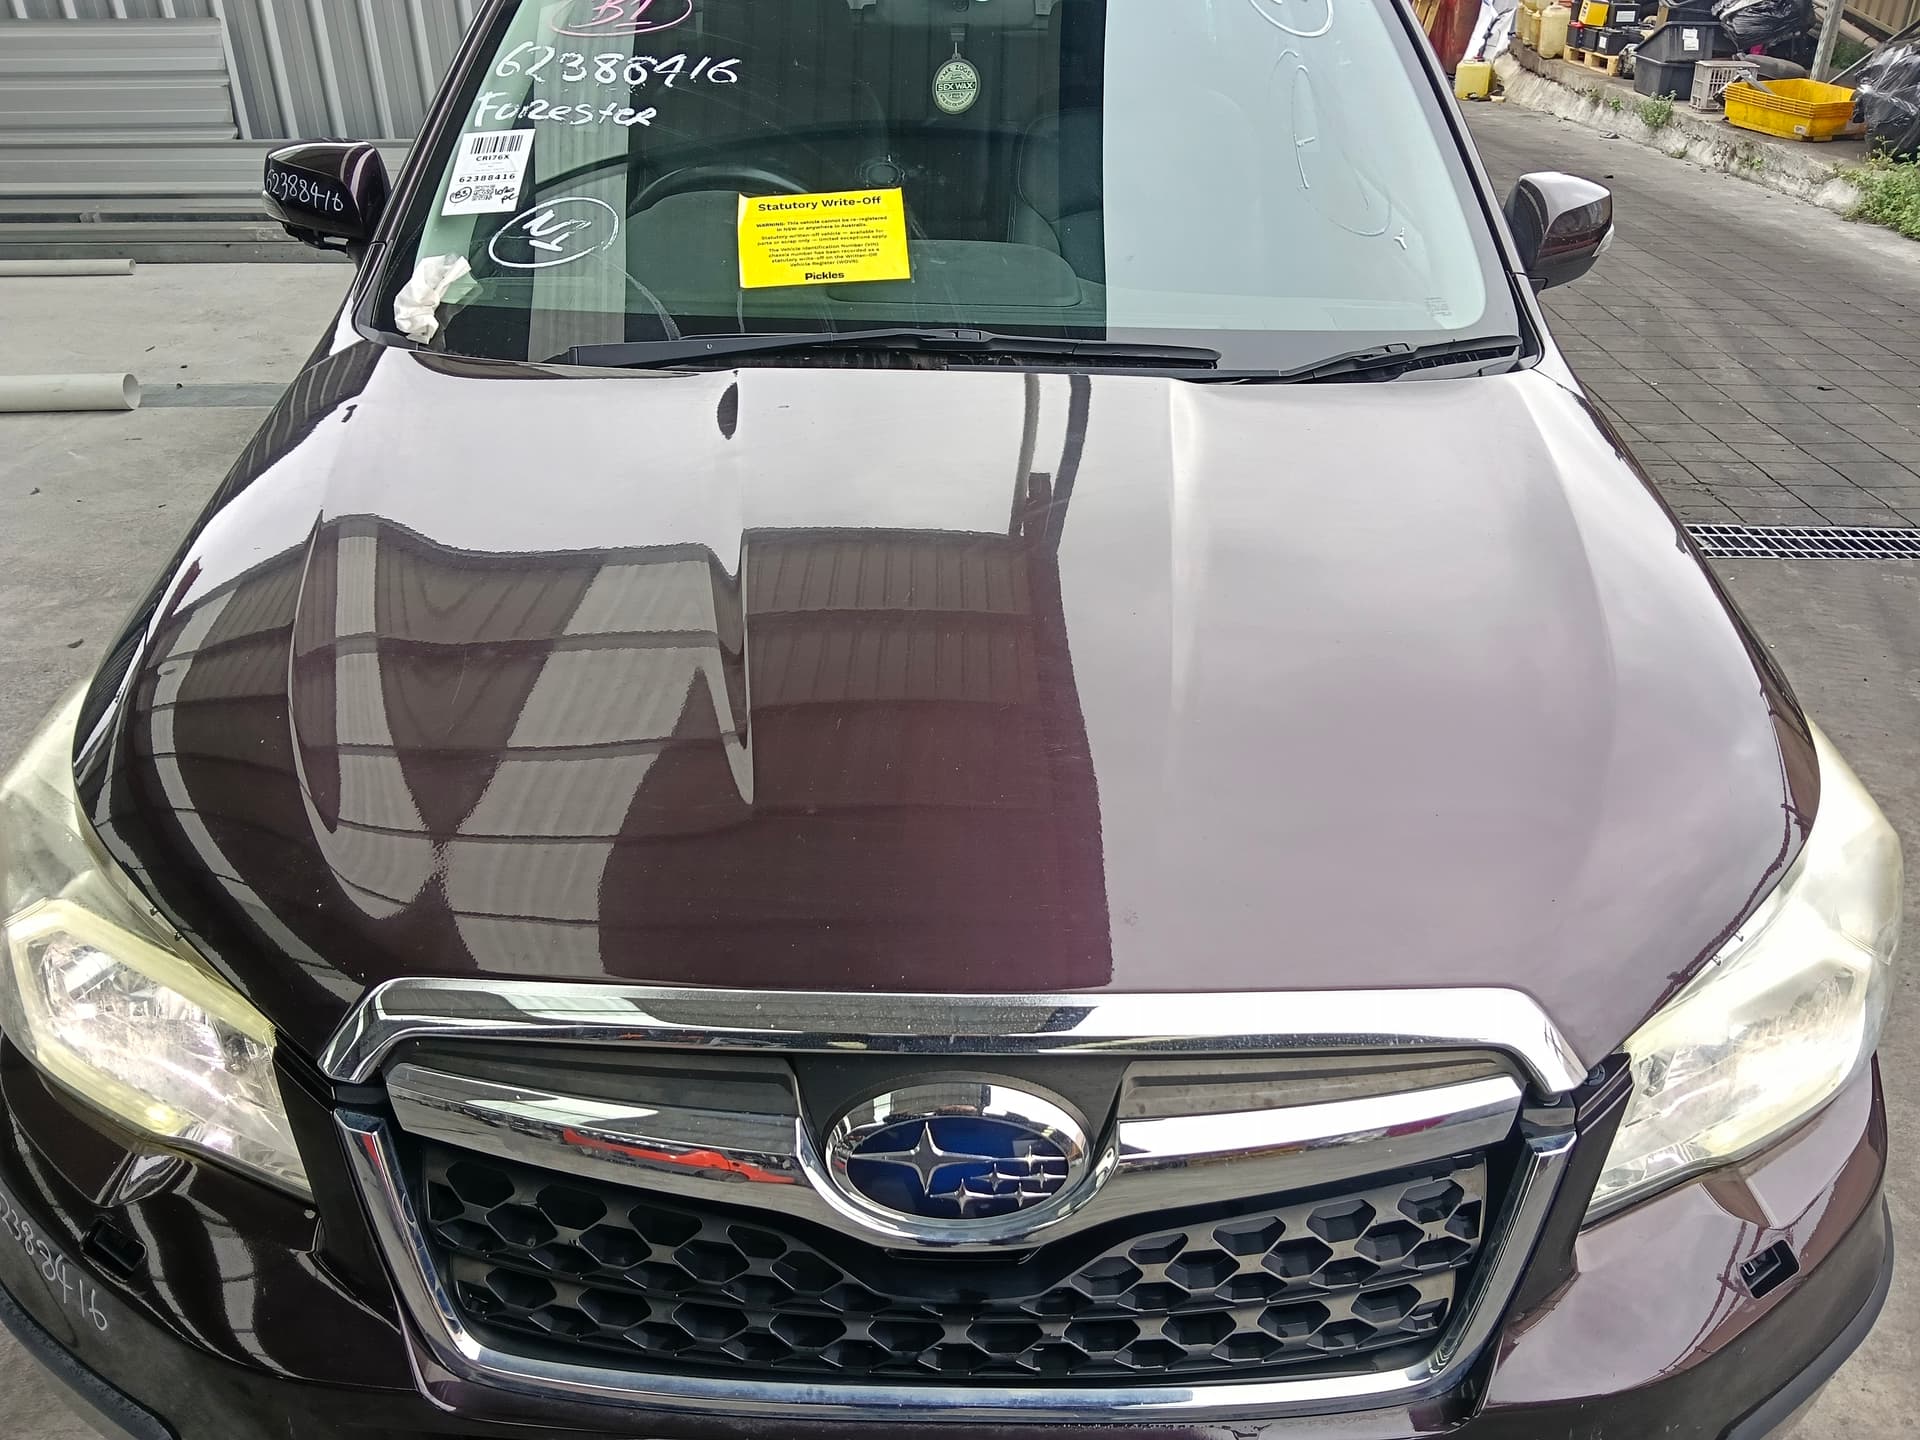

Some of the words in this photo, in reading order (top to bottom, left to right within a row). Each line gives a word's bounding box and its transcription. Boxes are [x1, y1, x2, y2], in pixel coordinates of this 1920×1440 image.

[495, 41, 743, 88] 62388416
[459, 173, 516, 183] 62388416
[266, 168, 344, 211] 62388416
[758, 201, 818, 212] Statutory
[821, 196, 881, 208] Write-Off
[805, 271, 845, 280] Pickles
